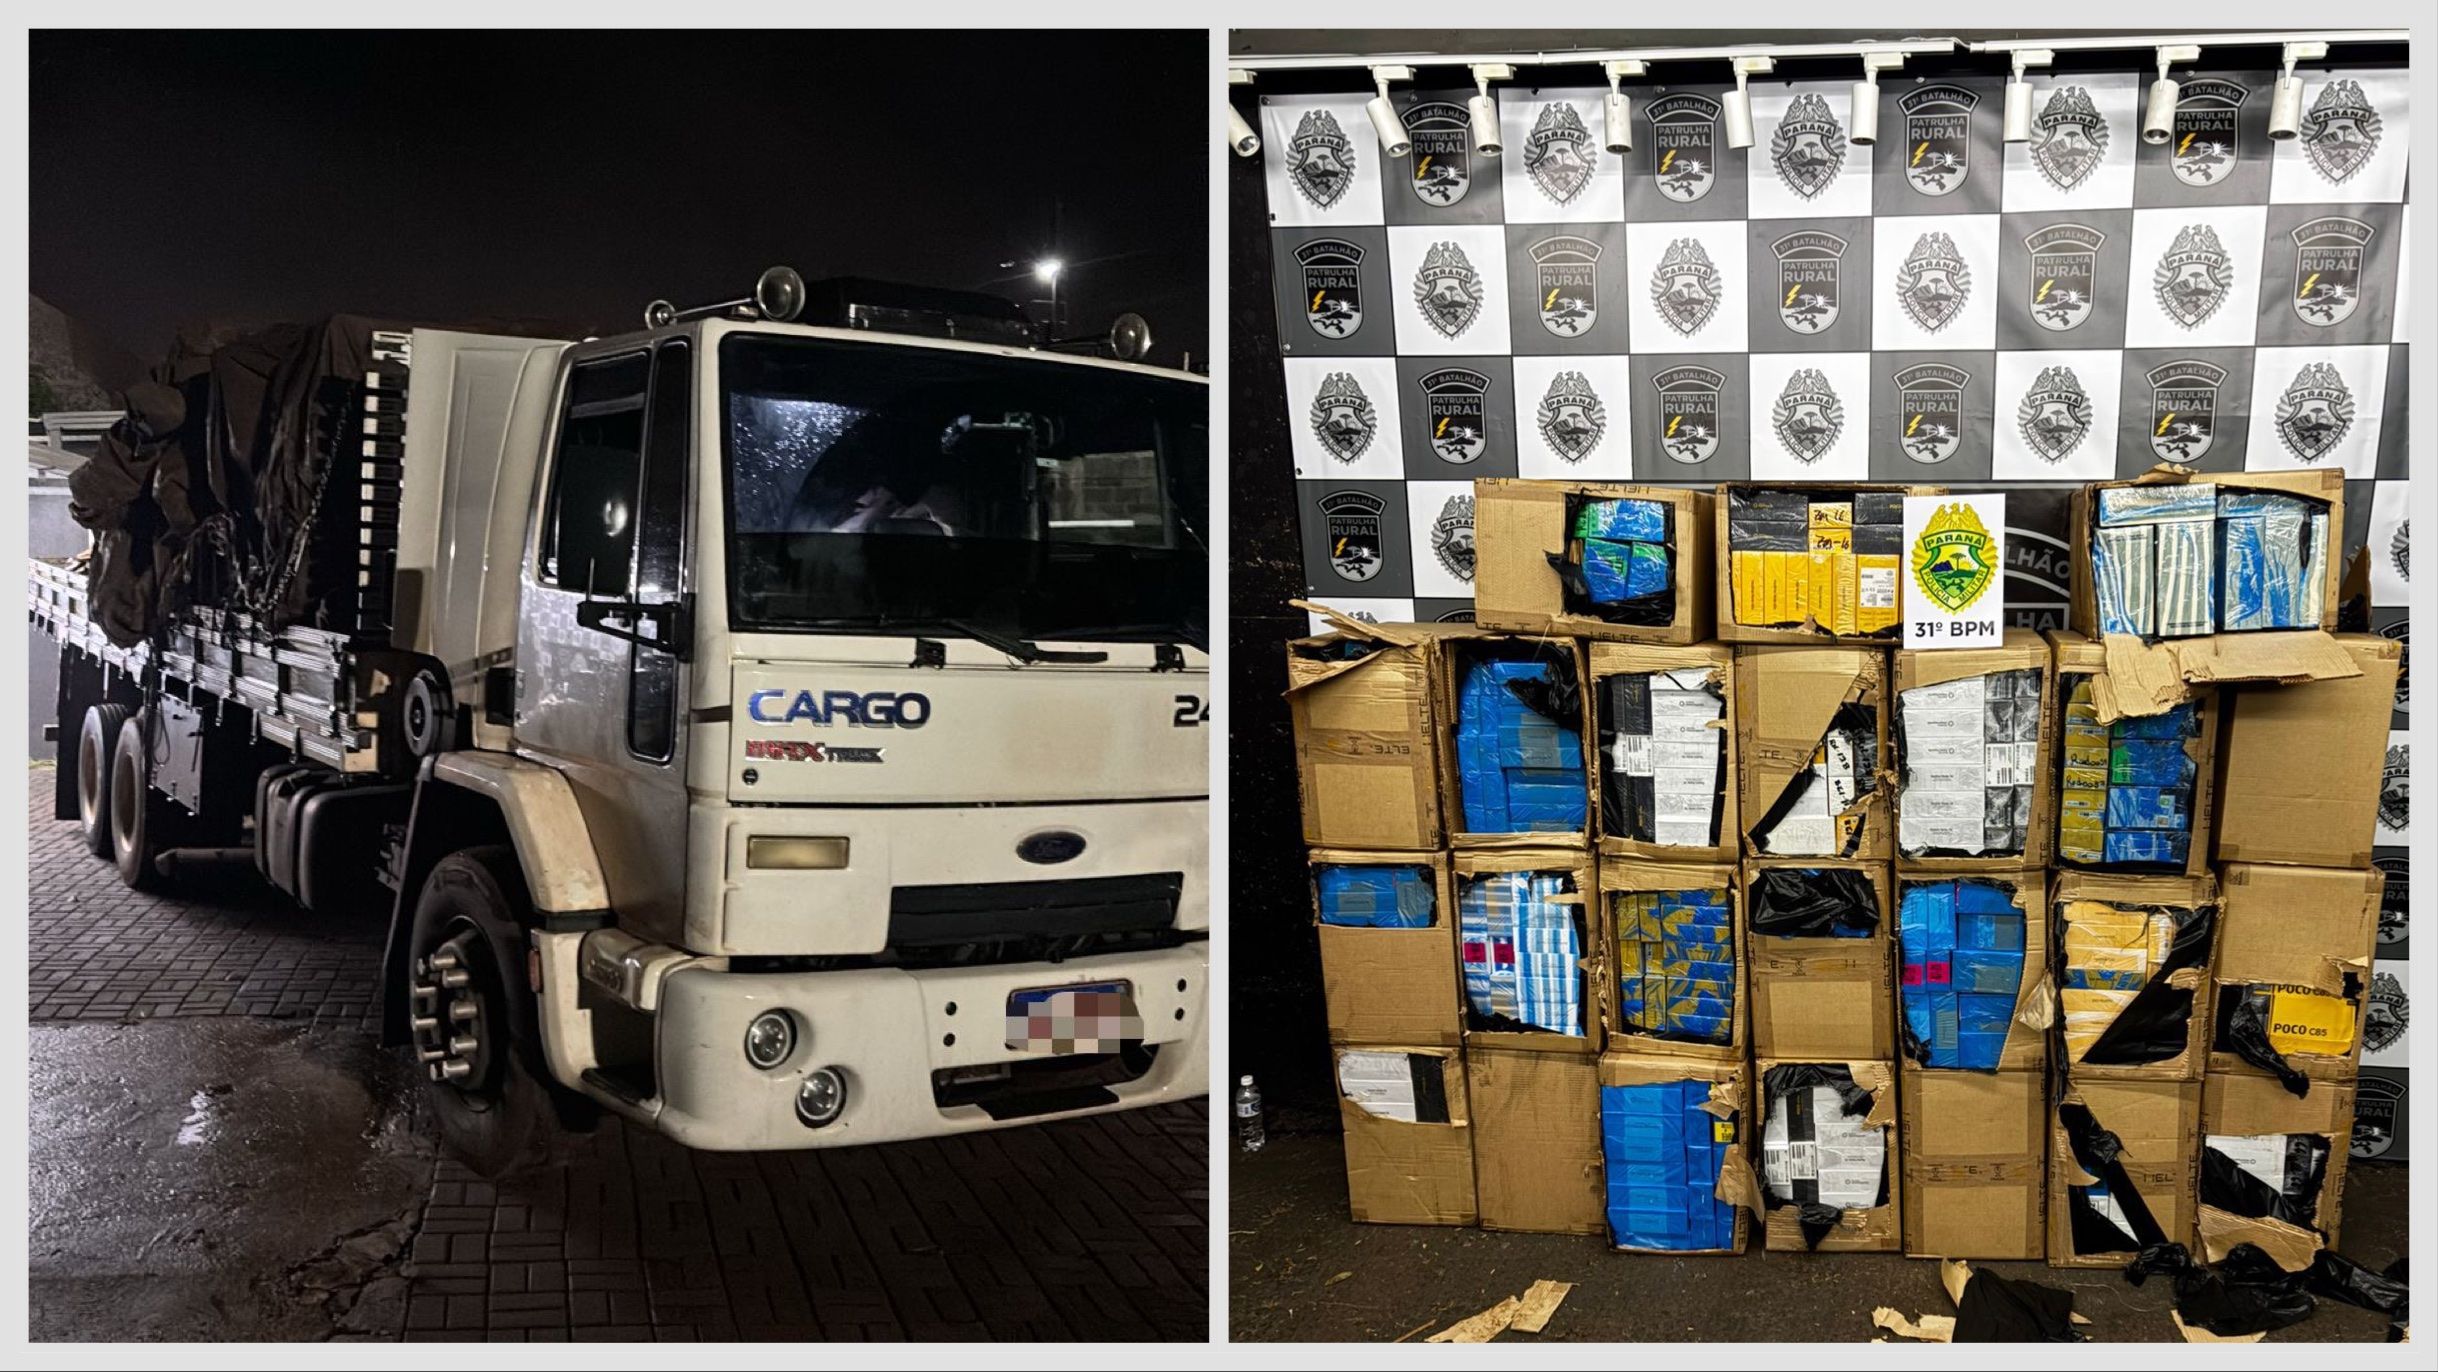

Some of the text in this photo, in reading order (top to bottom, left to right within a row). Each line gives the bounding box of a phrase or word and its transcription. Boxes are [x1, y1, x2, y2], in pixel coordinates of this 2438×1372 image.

[2188, 84, 2239, 98] BATALHÃO
[1922, 92, 1970, 104] BATALHÃO
[1667, 101, 1714, 113] BATALHÃO
[1421, 106, 1467, 122] BATALHÃO
[2045, 113, 2094, 125] PARANÁ
[2177, 112, 2232, 120] PATRULHA
[2314, 109, 2368, 120] PARANÁ
[1912, 118, 1965, 126] PATRULHA
[2177, 122, 2234, 130] RURAL
[1659, 126, 1709, 134] PATRULHA
[1785, 122, 1833, 135] PARANÁ
[1912, 128, 1965, 139] RURAL
[1298, 136, 1342, 149] PARANÁ
[1414, 133, 1463, 142] PATRULHA
[1537, 130, 1582, 143] PARANÁ
[1659, 135, 1710, 147] RURAL
[1415, 142, 1465, 153] RURAL
[2315, 224, 2365, 237] BATALHÃO
[1792, 237, 1840, 250] BATALHÃO
[1314, 246, 1357, 258] BATALHÃO
[1910, 260, 1958, 273] PARANÁ
[2170, 254, 2219, 267] PARANÁ
[2302, 260, 2357, 271] RURAL
[1425, 268, 1470, 279] PARANÁ
[1663, 265, 1708, 278] PARANÁ
[1784, 272, 1835, 282] RURAL
[2037, 267, 2090, 277] RURAL
[1308, 277, 1356, 288] RURAL
[1543, 275, 1592, 286] RURAL
[1673, 372, 1718, 383] BATALHÃO
[1915, 370, 1962, 382] BATALHÃO
[2169, 367, 2219, 379] BATALHÃO
[1439, 374, 1483, 386] BATALHÃO
[1433, 396, 1479, 404] PATRULHA
[2032, 394, 2079, 406] PARANÁ
[2158, 391, 2212, 399] PATRULHA
[2291, 390, 2341, 402] PARANÁ
[1320, 397, 1364, 409] PARANÁ
[1550, 396, 1593, 408] PARANÁ
[1785, 396, 1831, 407] PARANÁ
[1906, 402, 1957, 412] RURAL
[2158, 401, 2212, 410] RURAL
[1433, 405, 1480, 415] RURAL
[1665, 403, 1715, 413] RURAL
[1331, 526, 1377, 535] RURAL
[1927, 534, 1982, 548] PARANÁ
[2005, 545, 2070, 579] LHÃO
[1959, 570, 1984, 602] MILITAR
[1915, 622, 1943, 637] 31º
[1951, 620, 1994, 636] BPM
[747, 689, 931, 729] CARGO
[2277, 984, 2311, 995] POCO
[2273, 1023, 2328, 1036] POCO C85
